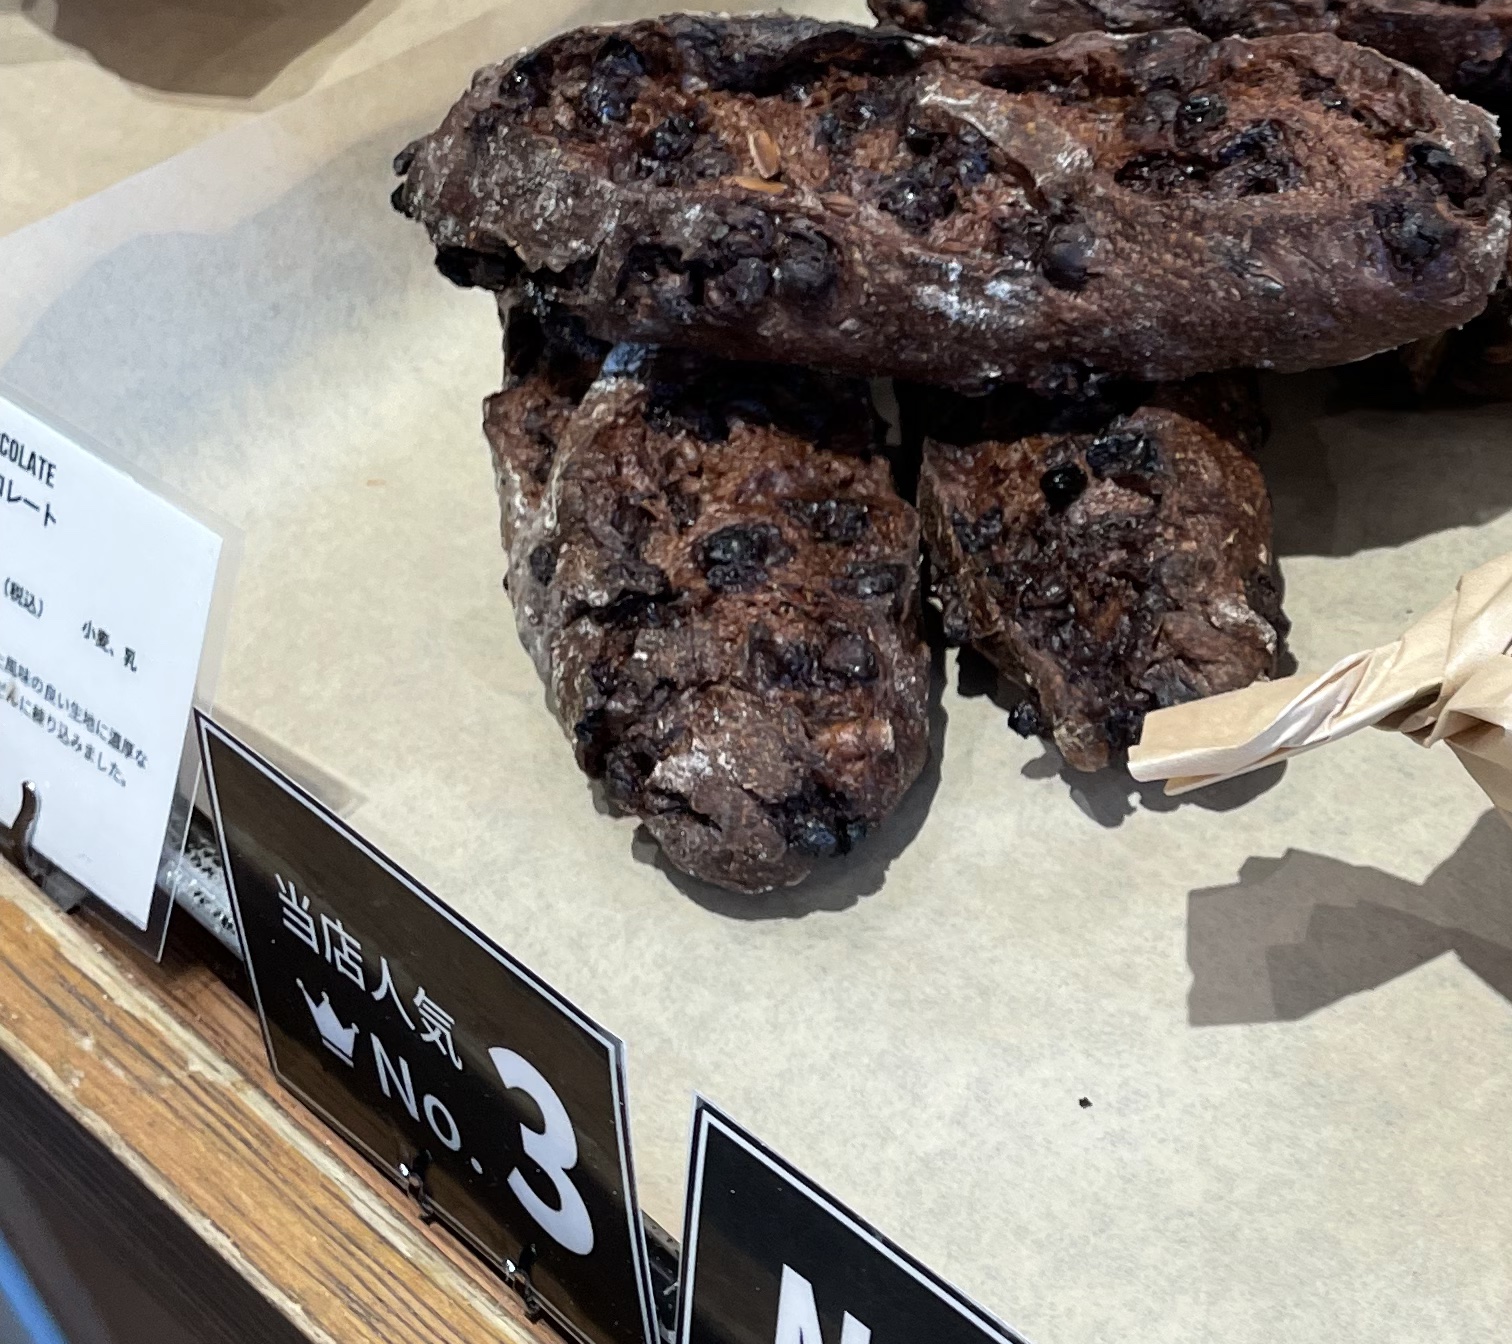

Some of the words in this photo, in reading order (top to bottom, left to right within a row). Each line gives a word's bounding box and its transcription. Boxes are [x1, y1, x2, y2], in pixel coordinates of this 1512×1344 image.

[0, 431, 57, 488] COLATE
[274, 872, 464, 1071] 当店人気
[369, 1031, 485, 1176] No.
[487, 1046, 595, 1256] 3
